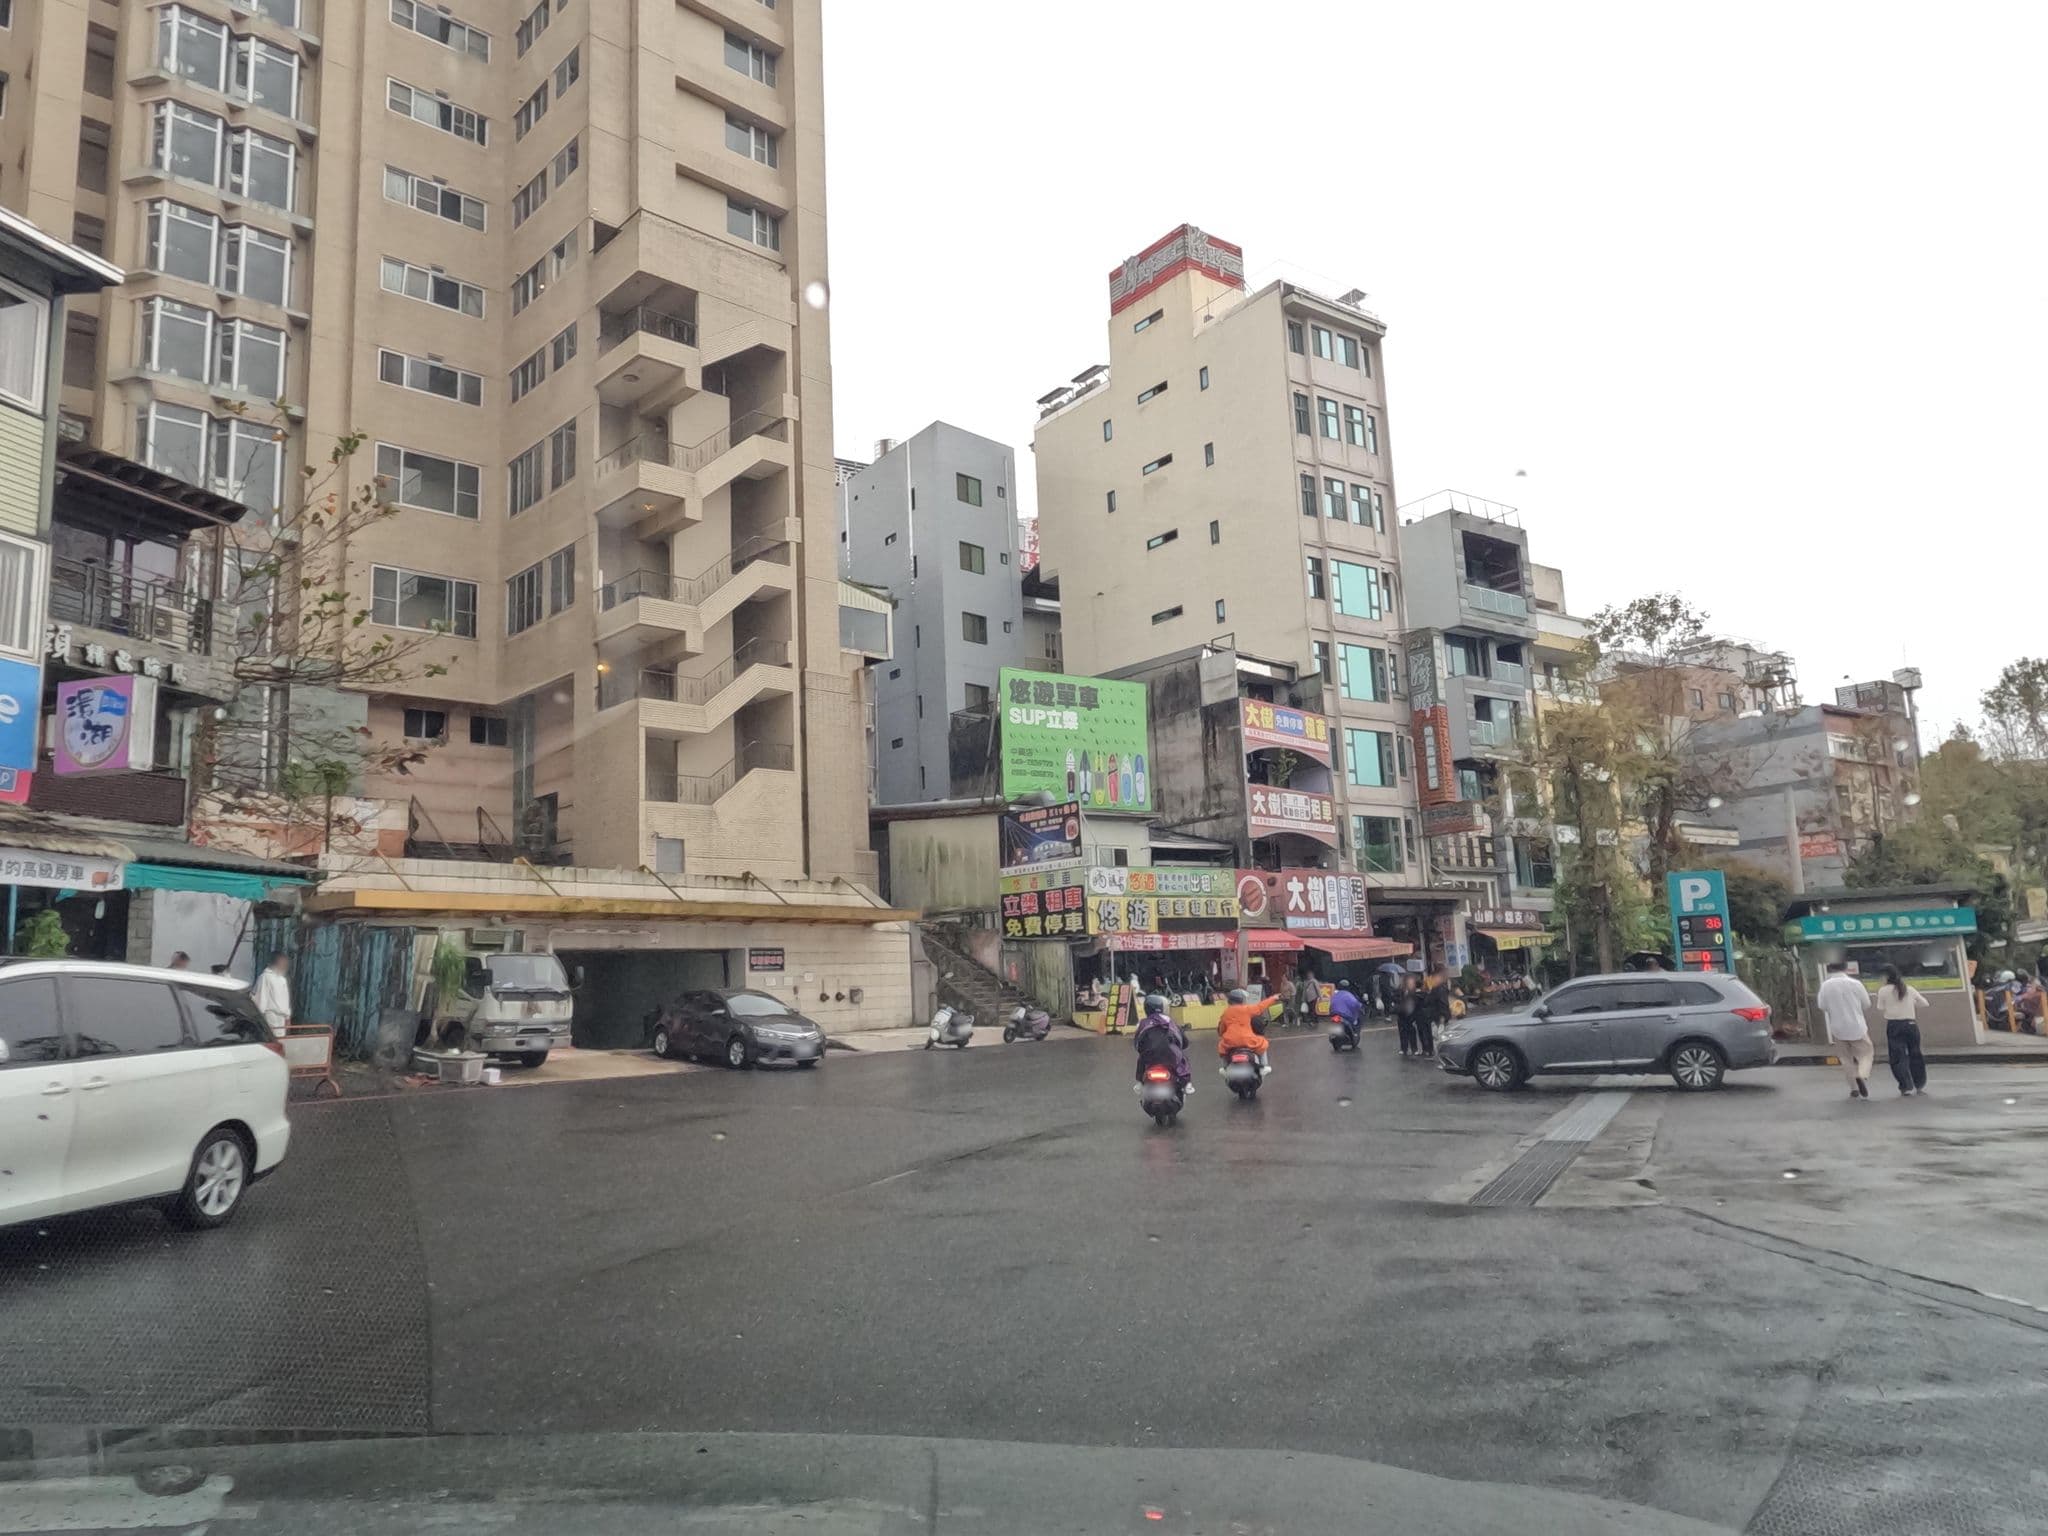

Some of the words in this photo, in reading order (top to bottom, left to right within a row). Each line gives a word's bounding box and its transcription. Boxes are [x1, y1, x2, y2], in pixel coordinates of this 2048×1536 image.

[1009, 678, 1099, 711] 悠遊單車
[0, 859, 85, 881] 的高級房車
[1045, 887, 1083, 912] 租車
[1286, 875, 1326, 912] 大樹
[1680, 878, 1711, 912] P
[1096, 899, 1150, 932] 悠遊
[1705, 918, 1722, 929] 36
